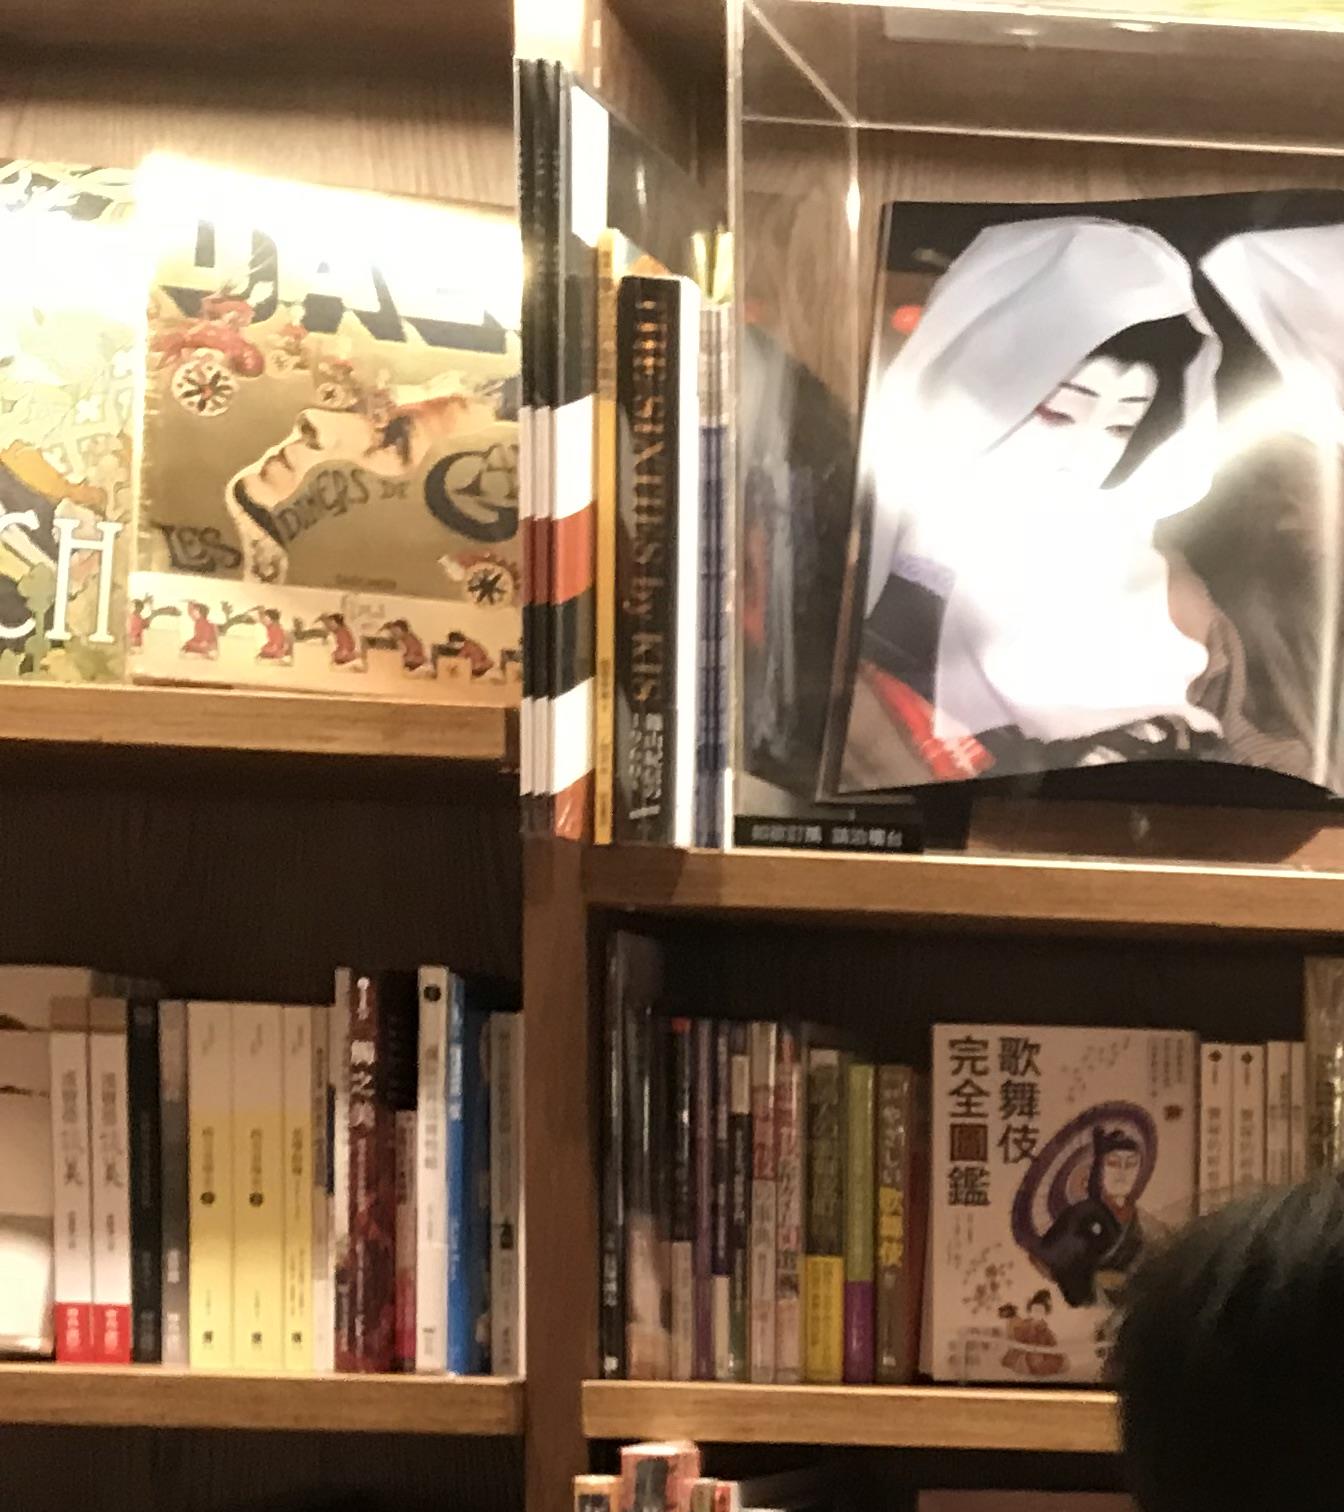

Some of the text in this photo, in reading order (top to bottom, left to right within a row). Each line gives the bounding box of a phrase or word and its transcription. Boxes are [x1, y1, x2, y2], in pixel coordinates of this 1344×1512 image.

[632, 395, 665, 564] SIXTIES
[157, 525, 243, 573] LES
[623, 579, 663, 621] by
[947, 1036, 991, 1208] 完全圖鑑
[998, 1036, 1043, 1165] 歌舞伎
